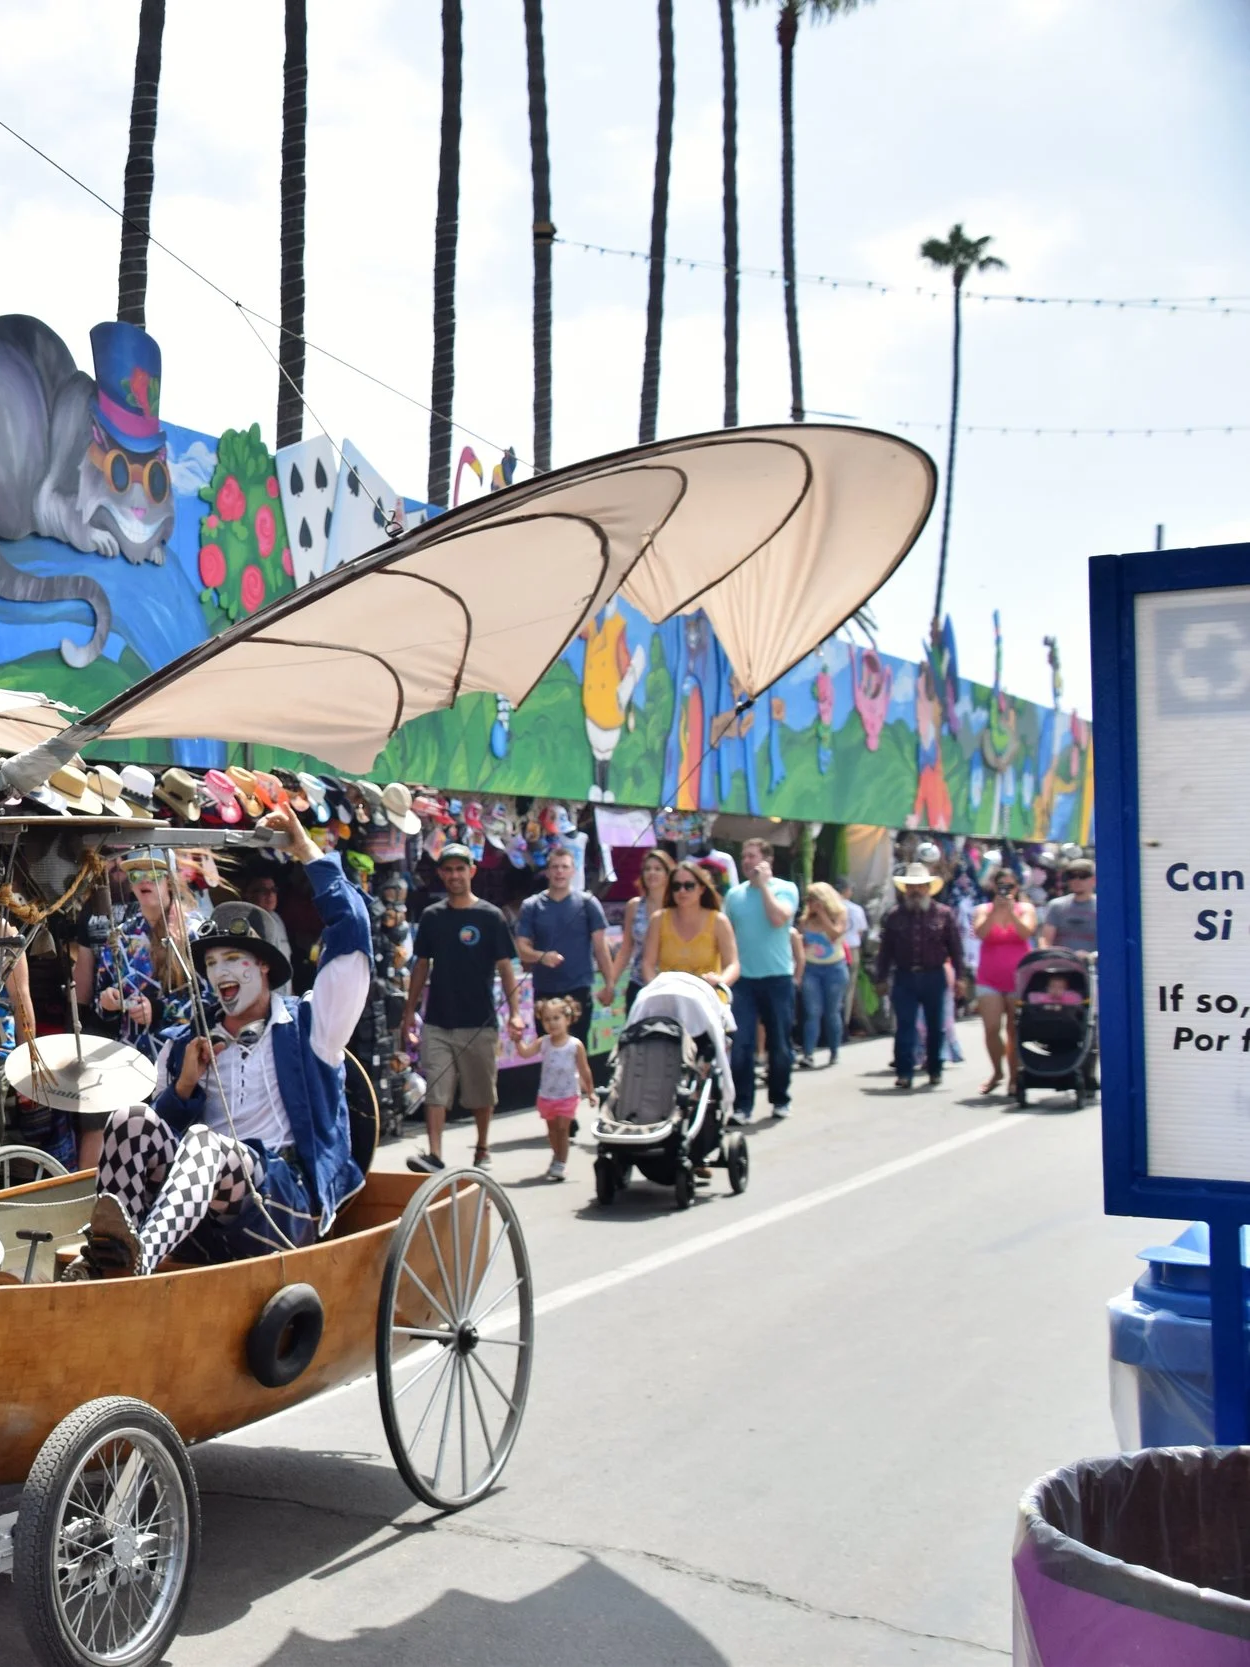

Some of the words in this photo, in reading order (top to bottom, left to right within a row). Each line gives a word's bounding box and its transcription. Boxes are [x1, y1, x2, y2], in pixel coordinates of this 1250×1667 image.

[1166, 862, 1244, 892] Can
[1194, 909, 1233, 941] Si
[1159, 983, 1184, 1012] If
[1173, 1026, 1230, 1051] Por
